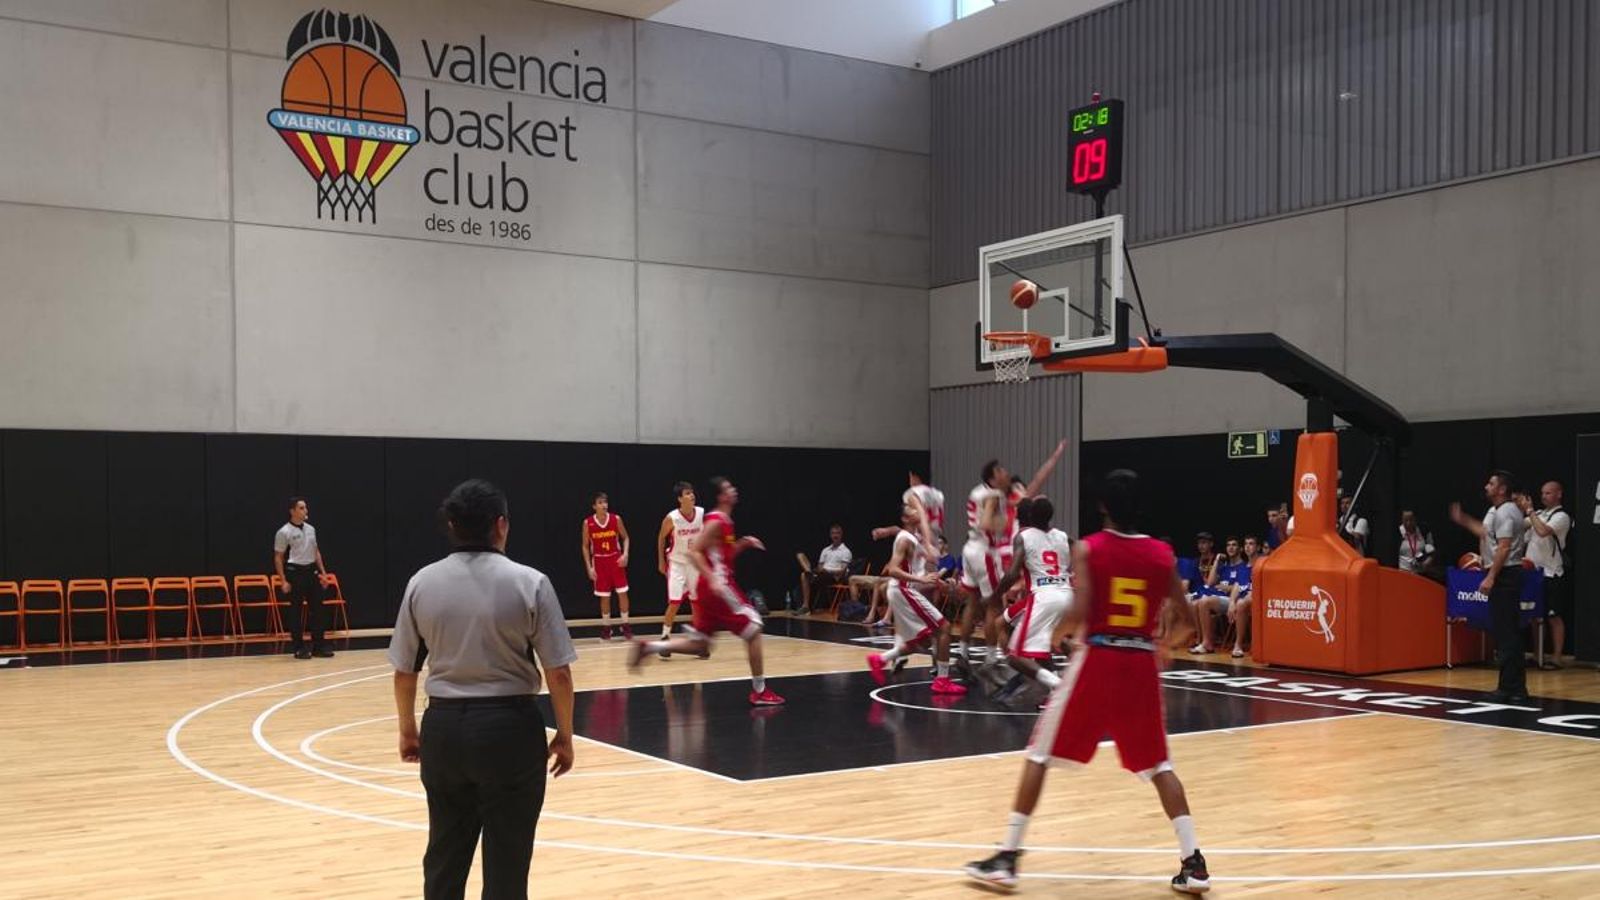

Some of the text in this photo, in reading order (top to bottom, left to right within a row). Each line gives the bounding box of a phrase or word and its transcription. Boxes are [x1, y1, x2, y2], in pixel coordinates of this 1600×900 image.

[422, 35, 606, 103] valencia
[277, 112, 413, 142] VALENCIA BASKET
[424, 89, 577, 162] basket
[423, 153, 529, 213] club
[1073, 138, 1108, 185] 09
[425, 213, 532, 241] des de 1986
[1042, 550, 1060, 576] 9
[1108, 577, 1148, 628] 5
[1267, 609, 1316, 620] DEL BASKET
[1457, 590, 1489, 602] molte
[1161, 669, 1542, 715] BASKET
